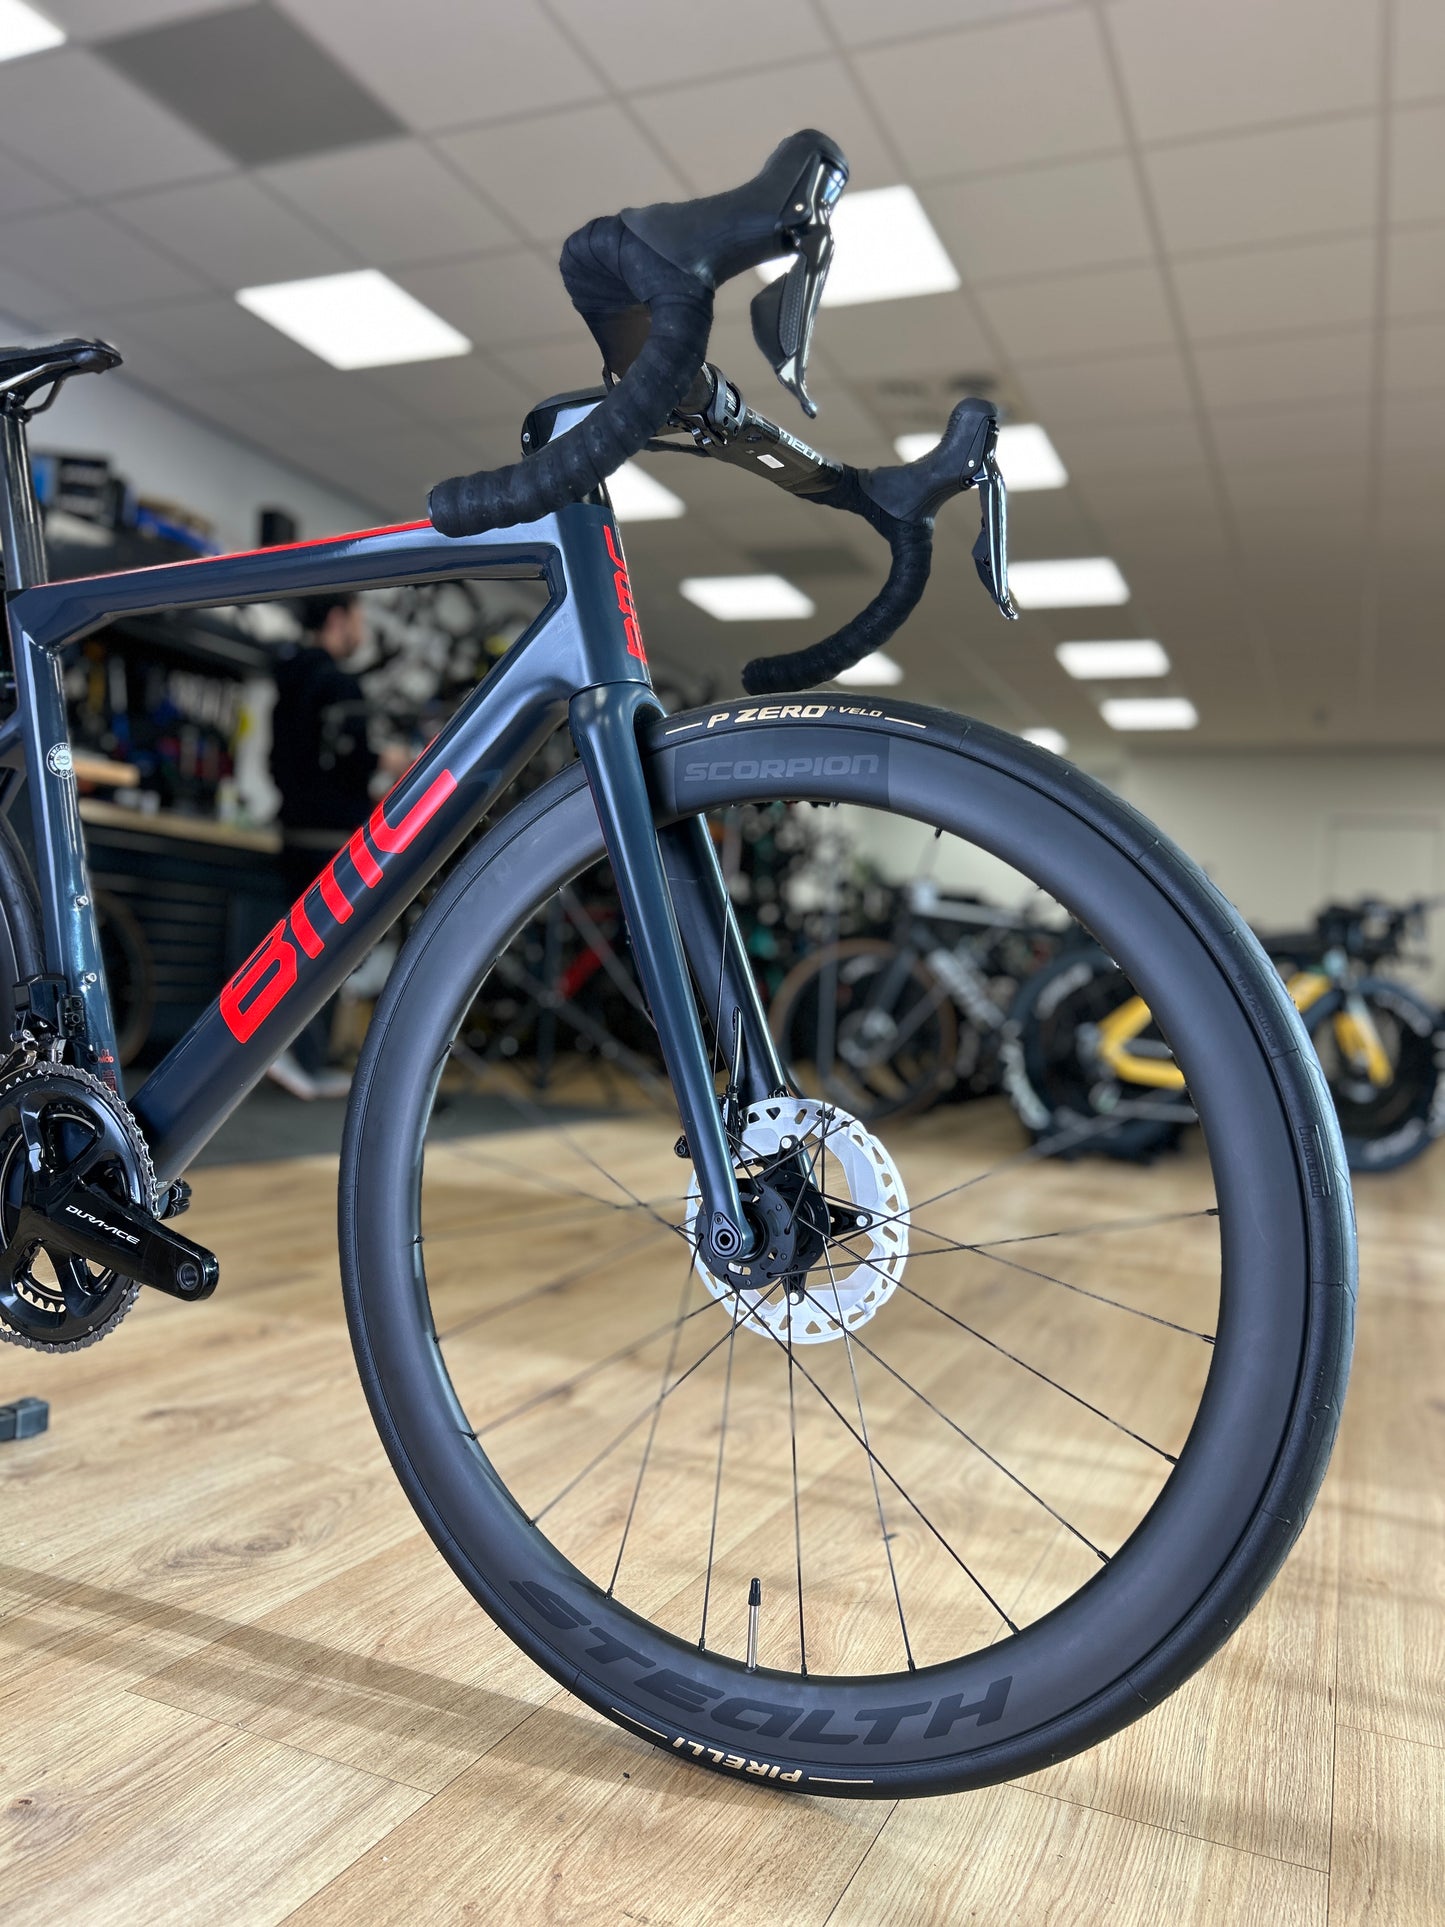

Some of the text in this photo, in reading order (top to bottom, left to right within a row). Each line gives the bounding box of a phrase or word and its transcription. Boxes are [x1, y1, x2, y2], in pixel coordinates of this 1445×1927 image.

[706, 704, 883, 729] P ZERO VELO
[684, 753, 880, 782] SCORPION
[219, 737, 458, 1044] BMC
[65, 1204, 140, 1245] DURA-ACE
[508, 1578, 1013, 1746] STEALTH
[672, 1736, 803, 1783] PIRELLI
